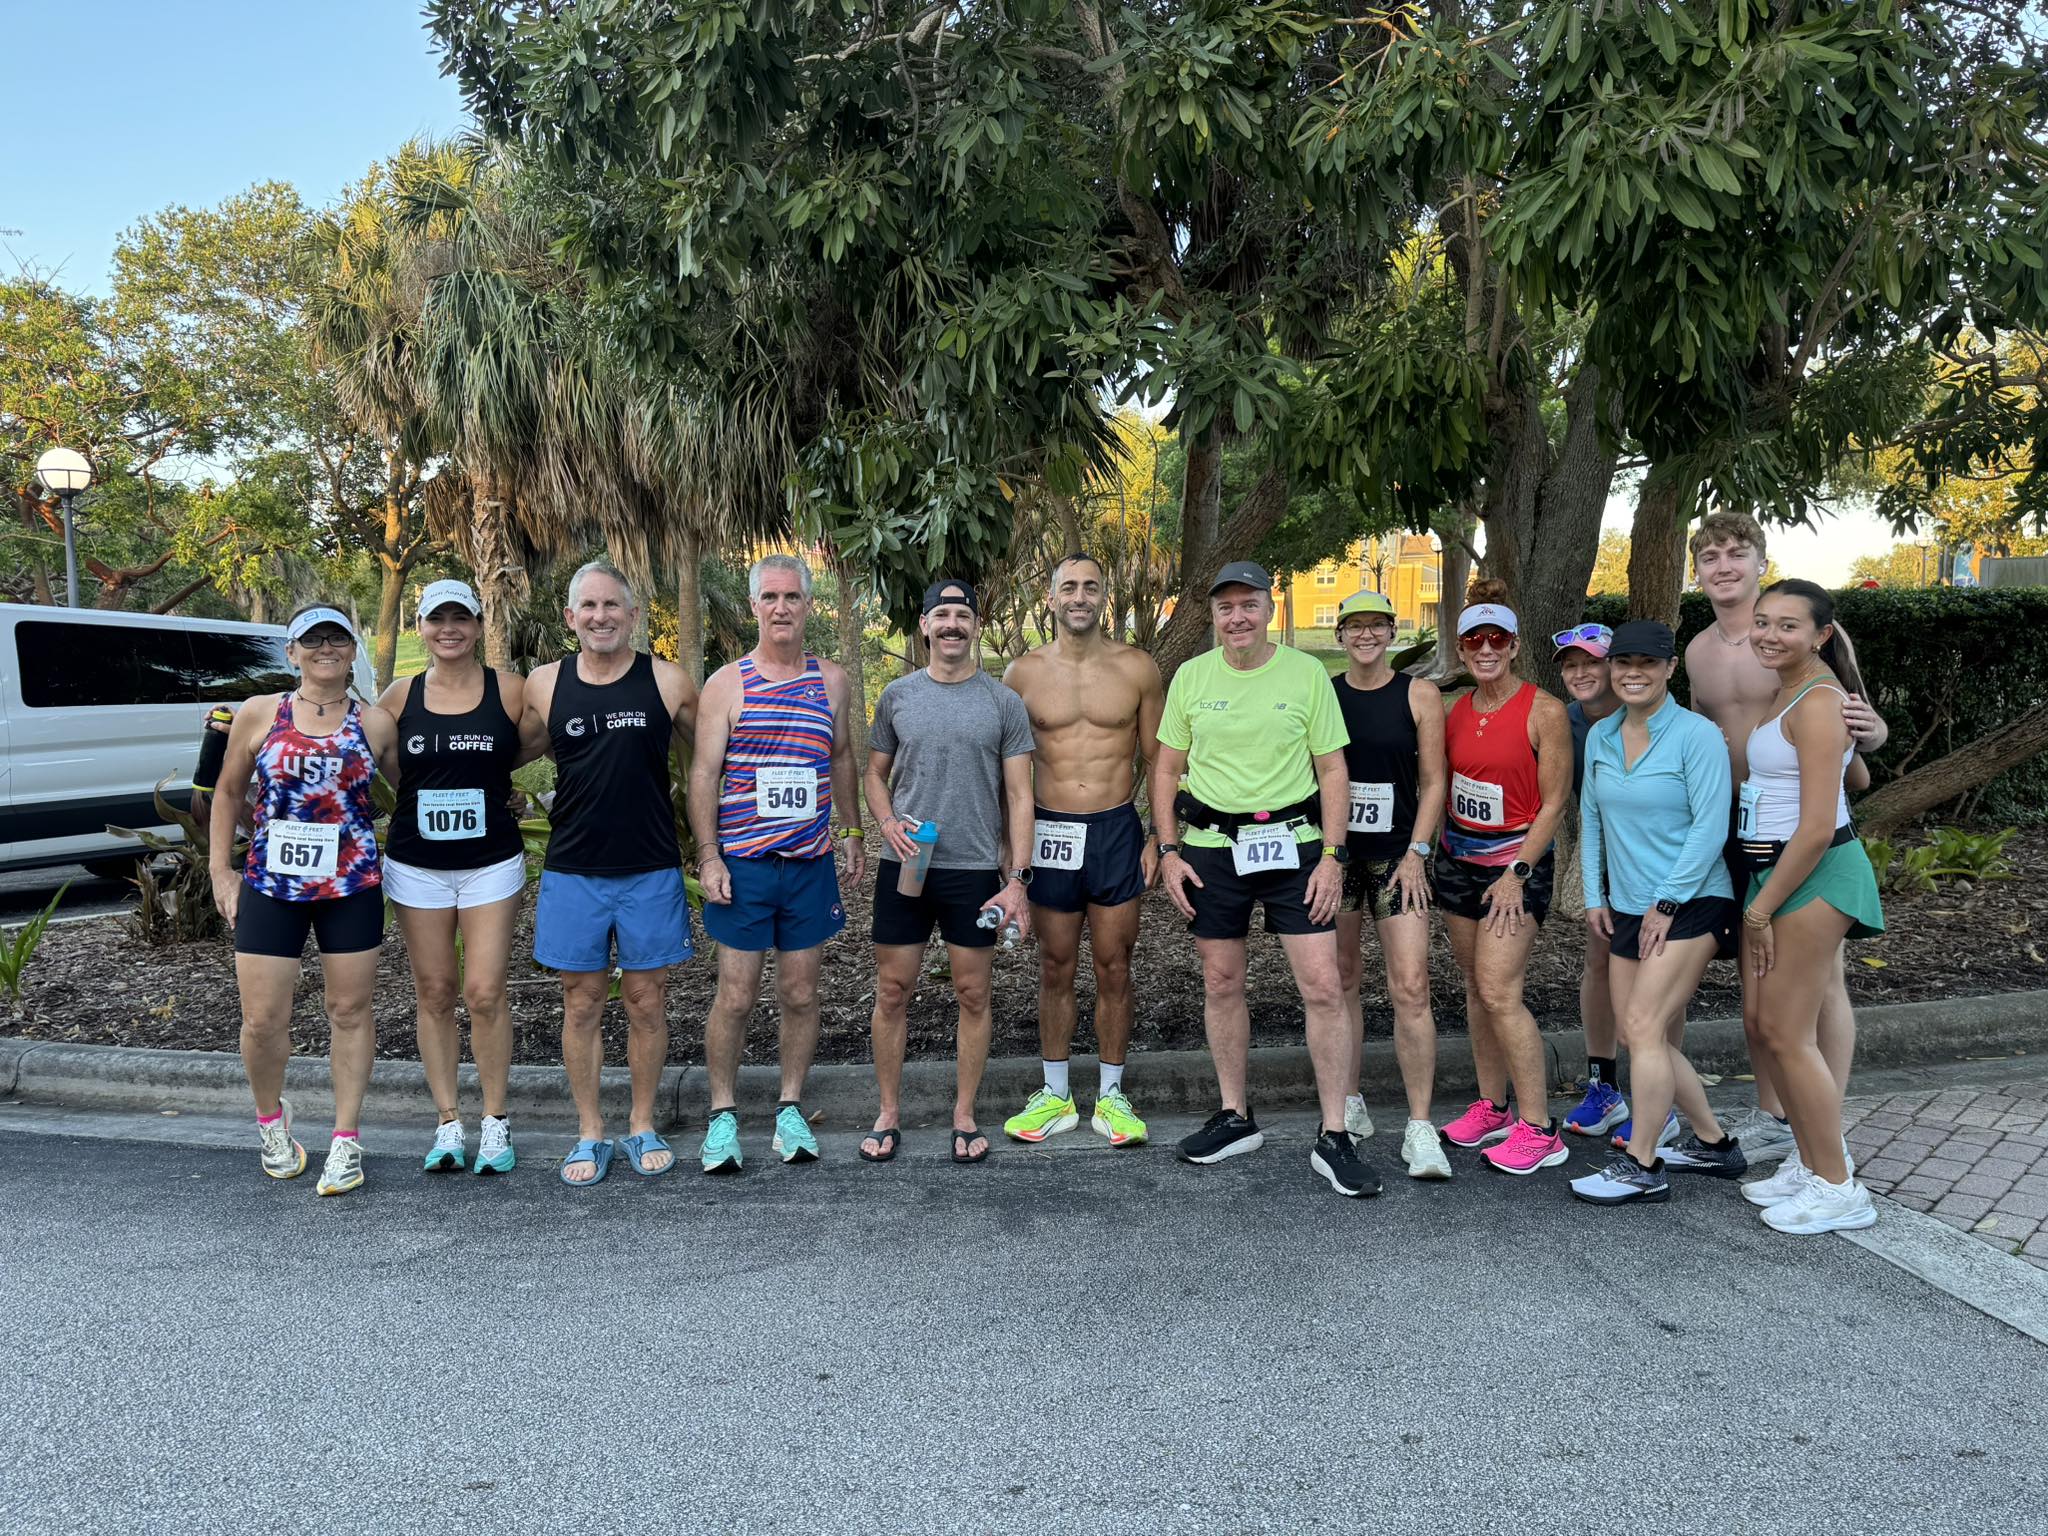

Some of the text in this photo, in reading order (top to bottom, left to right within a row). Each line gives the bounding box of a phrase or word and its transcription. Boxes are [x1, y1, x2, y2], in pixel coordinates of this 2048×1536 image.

[605, 712, 617, 720] WE
[606, 718, 647, 730] COFFEE
[448, 741, 494, 752] COFFEE
[767, 787, 808, 809] 549
[1456, 794, 1492, 822] 668
[285, 824, 301, 832] FLEET
[425, 808, 477, 833] 1076
[280, 842, 324, 868] 657
[1040, 839, 1073, 862] 675
[1247, 840, 1284, 864] 472
